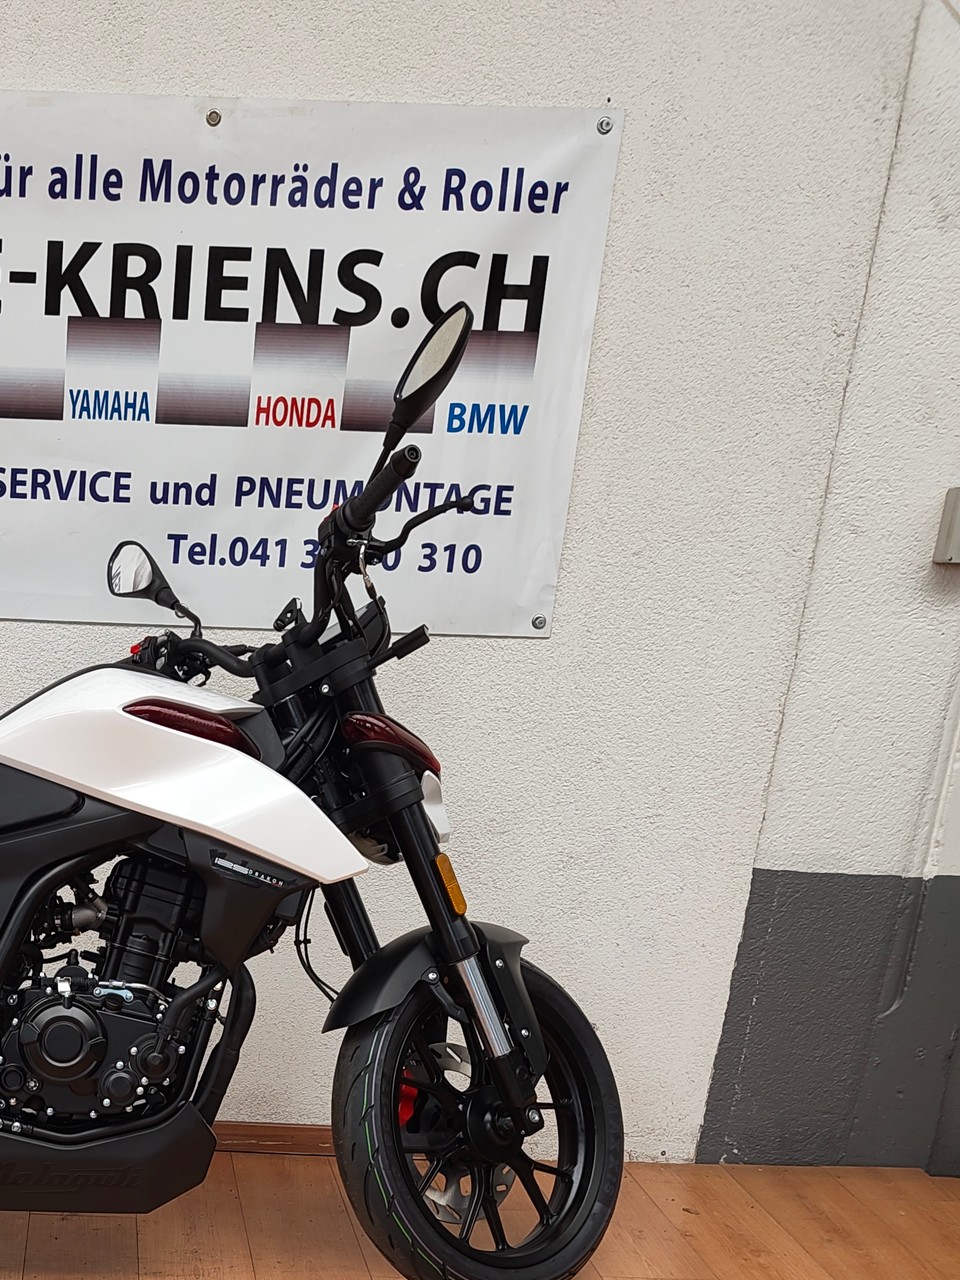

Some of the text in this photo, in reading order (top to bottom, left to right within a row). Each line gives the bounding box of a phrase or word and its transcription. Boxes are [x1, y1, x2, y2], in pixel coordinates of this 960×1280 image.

[47, 154, 123, 202] alle
[140, 158, 383, 210] Motorräder
[397, 167, 426, 210] &
[442, 167, 569, 214] Roller
[69, 389, 150, 422] YAMAHA
[255, 395, 336, 429] HONDA
[446, 403, 530, 435] BMW
[149, 474, 217, 507] und
[235, 476, 514, 517] PNEUMNTAGE
[418, 543, 483, 574] 310
